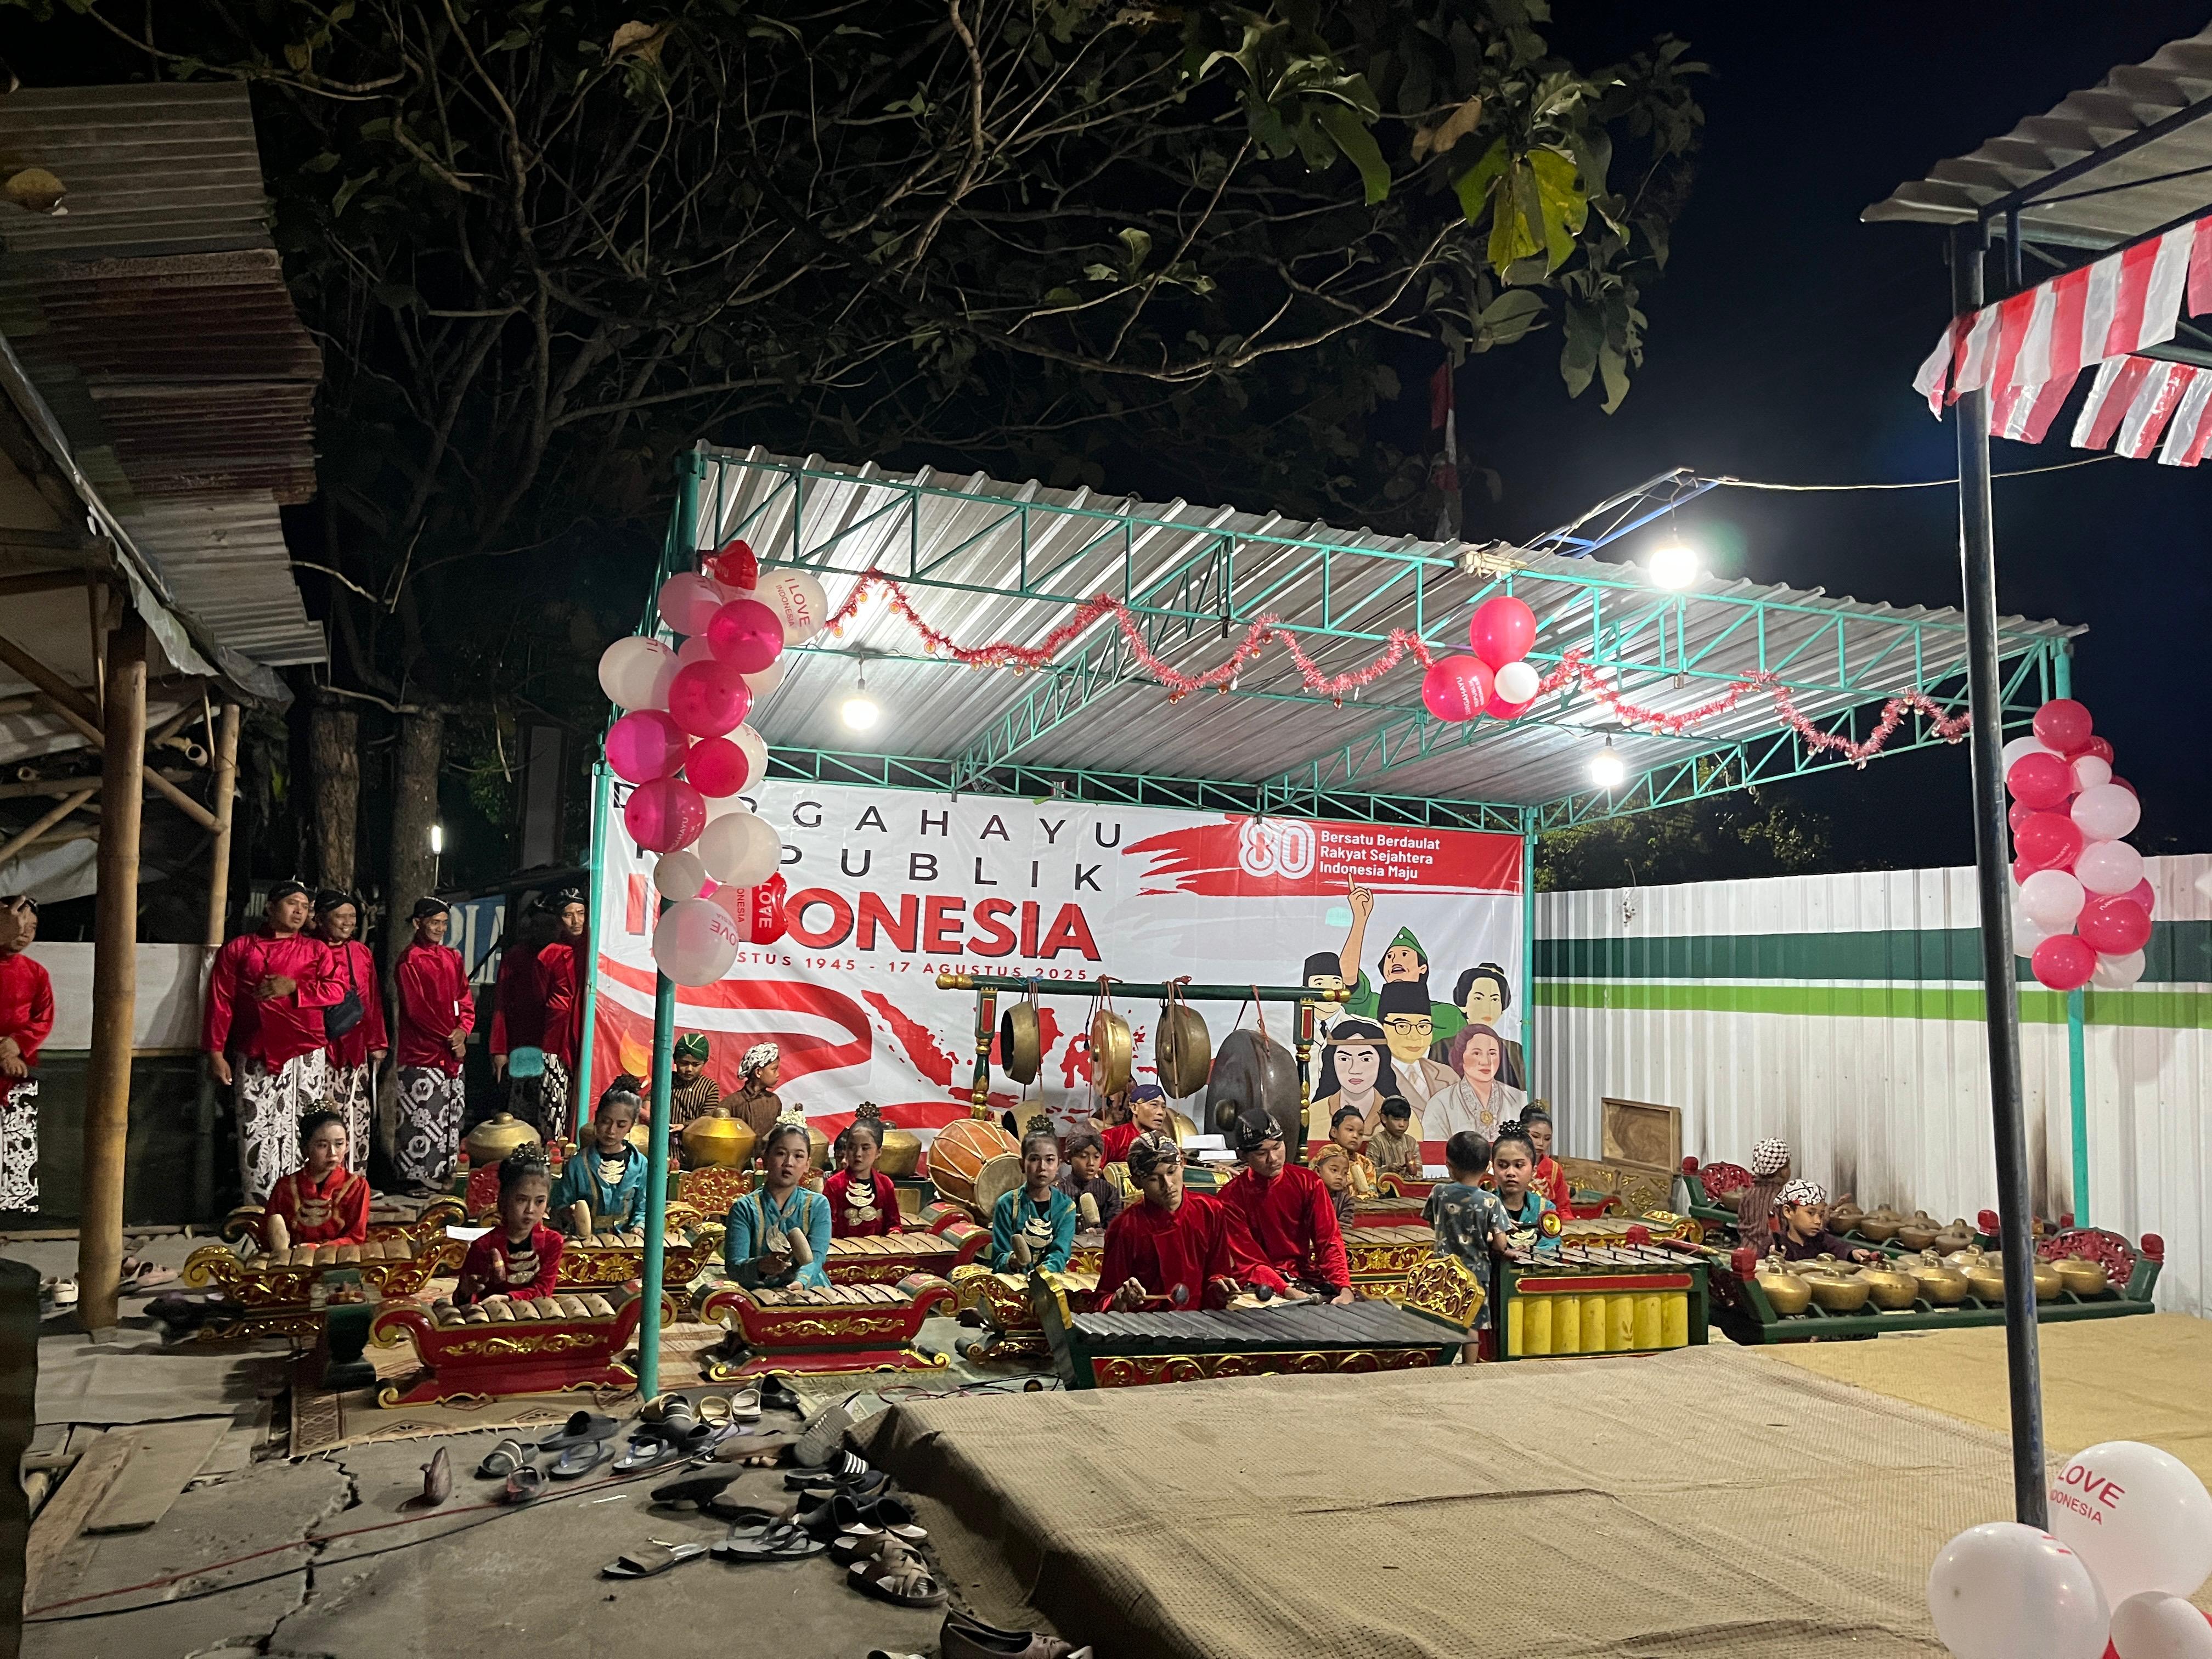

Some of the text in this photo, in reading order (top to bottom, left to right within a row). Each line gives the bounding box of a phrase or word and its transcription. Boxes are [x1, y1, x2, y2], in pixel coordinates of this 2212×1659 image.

[775, 584, 795, 627] INDONESIA
[788, 585, 810, 627] LOVE
[614, 781, 1120, 848] DGAHAYU
[1238, 816, 1316, 879] 80
[1320, 845, 1434, 865] Rakyat Sejahtera
[1321, 830, 1440, 850] Bersatu Berdaulat
[636, 844, 1103, 892] PUBLIK
[1319, 861, 1418, 881] Indonesia Maju
[625, 872, 1102, 962] IONESIA
[709, 919, 737, 946] OVE
[737, 952, 791, 966] STUS
[805, 957, 855, 970] 1945
[888, 961, 910, 973] 17
[922, 963, 1022, 978] AGUSTUS
[1035, 967, 1086, 980] 2025
[2050, 1489, 2102, 1526] DONESIA
